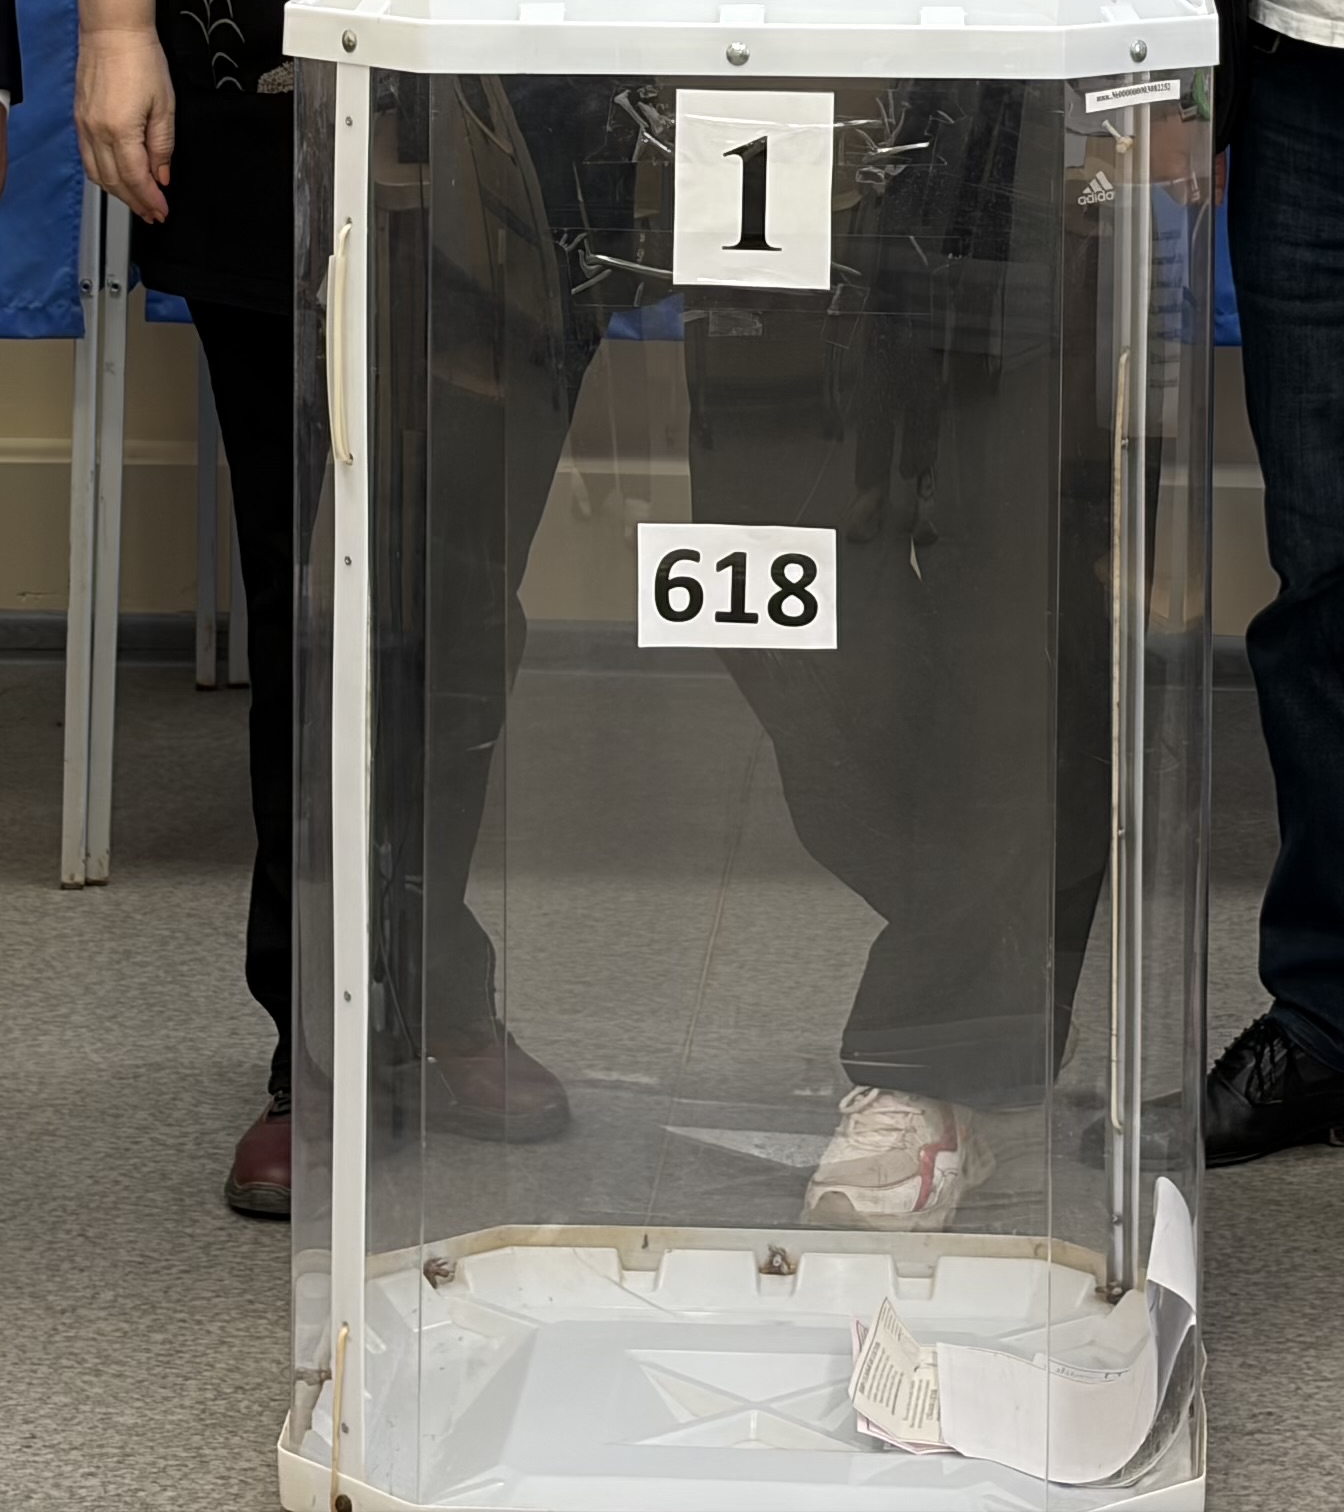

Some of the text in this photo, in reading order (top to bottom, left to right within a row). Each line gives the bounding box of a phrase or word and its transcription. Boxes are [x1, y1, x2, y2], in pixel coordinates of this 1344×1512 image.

[722, 135, 782, 252] 1
[1077, 189, 1116, 206] adida
[654, 548, 819, 628] 618
